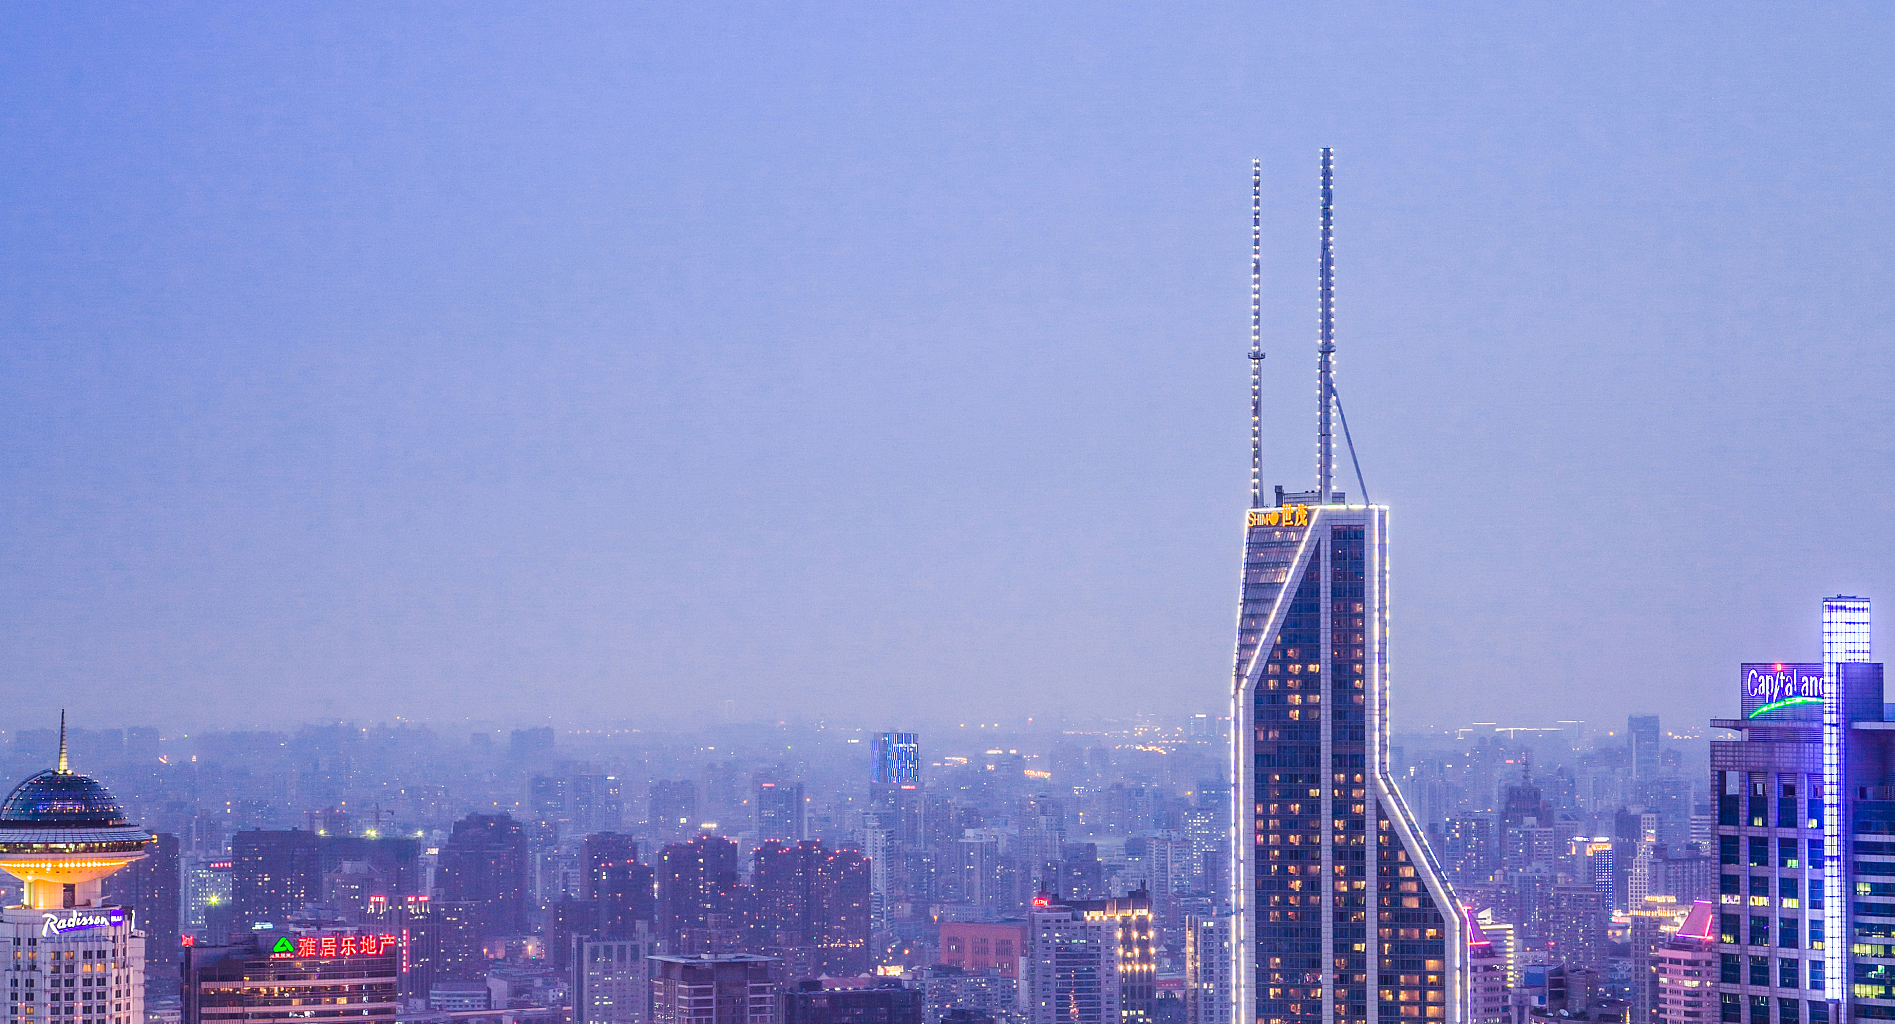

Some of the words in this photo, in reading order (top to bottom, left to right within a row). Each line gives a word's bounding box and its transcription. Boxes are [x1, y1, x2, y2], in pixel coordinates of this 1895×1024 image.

[1280, 504, 1308, 527] 世茂
[42, 910, 109, 937] Radisson
[298, 934, 396, 957] 雅居乐地产
